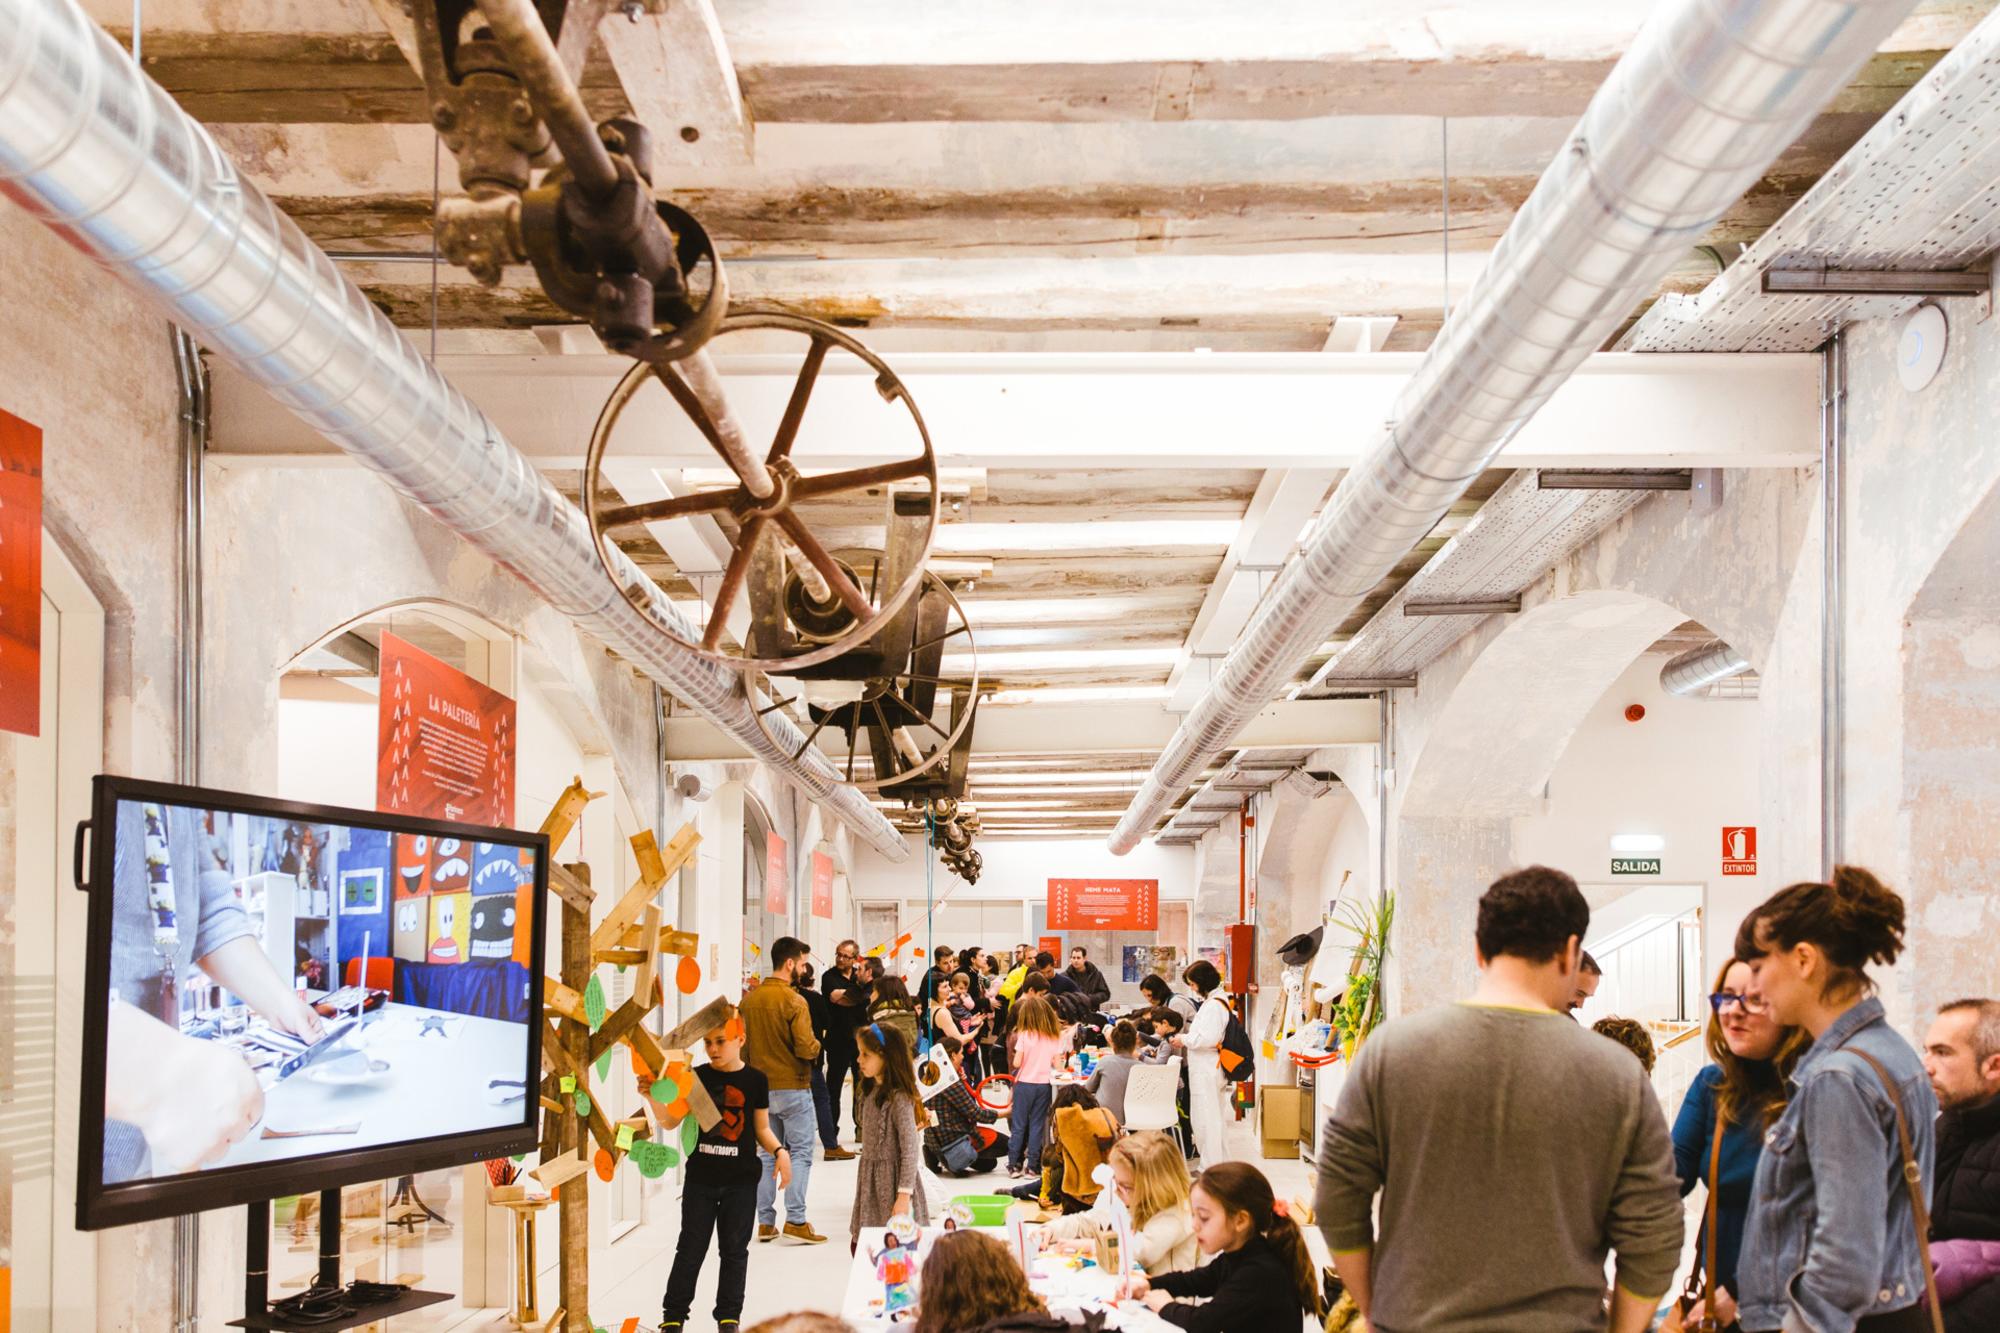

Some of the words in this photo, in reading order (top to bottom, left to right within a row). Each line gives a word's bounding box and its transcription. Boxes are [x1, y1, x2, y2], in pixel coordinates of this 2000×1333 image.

[429, 694, 440, 713] LA
[442, 700, 481, 732] PALETERÍA
[1612, 861, 1659, 872] SALIDA
[1723, 864, 1756, 873] EXTINTOR
